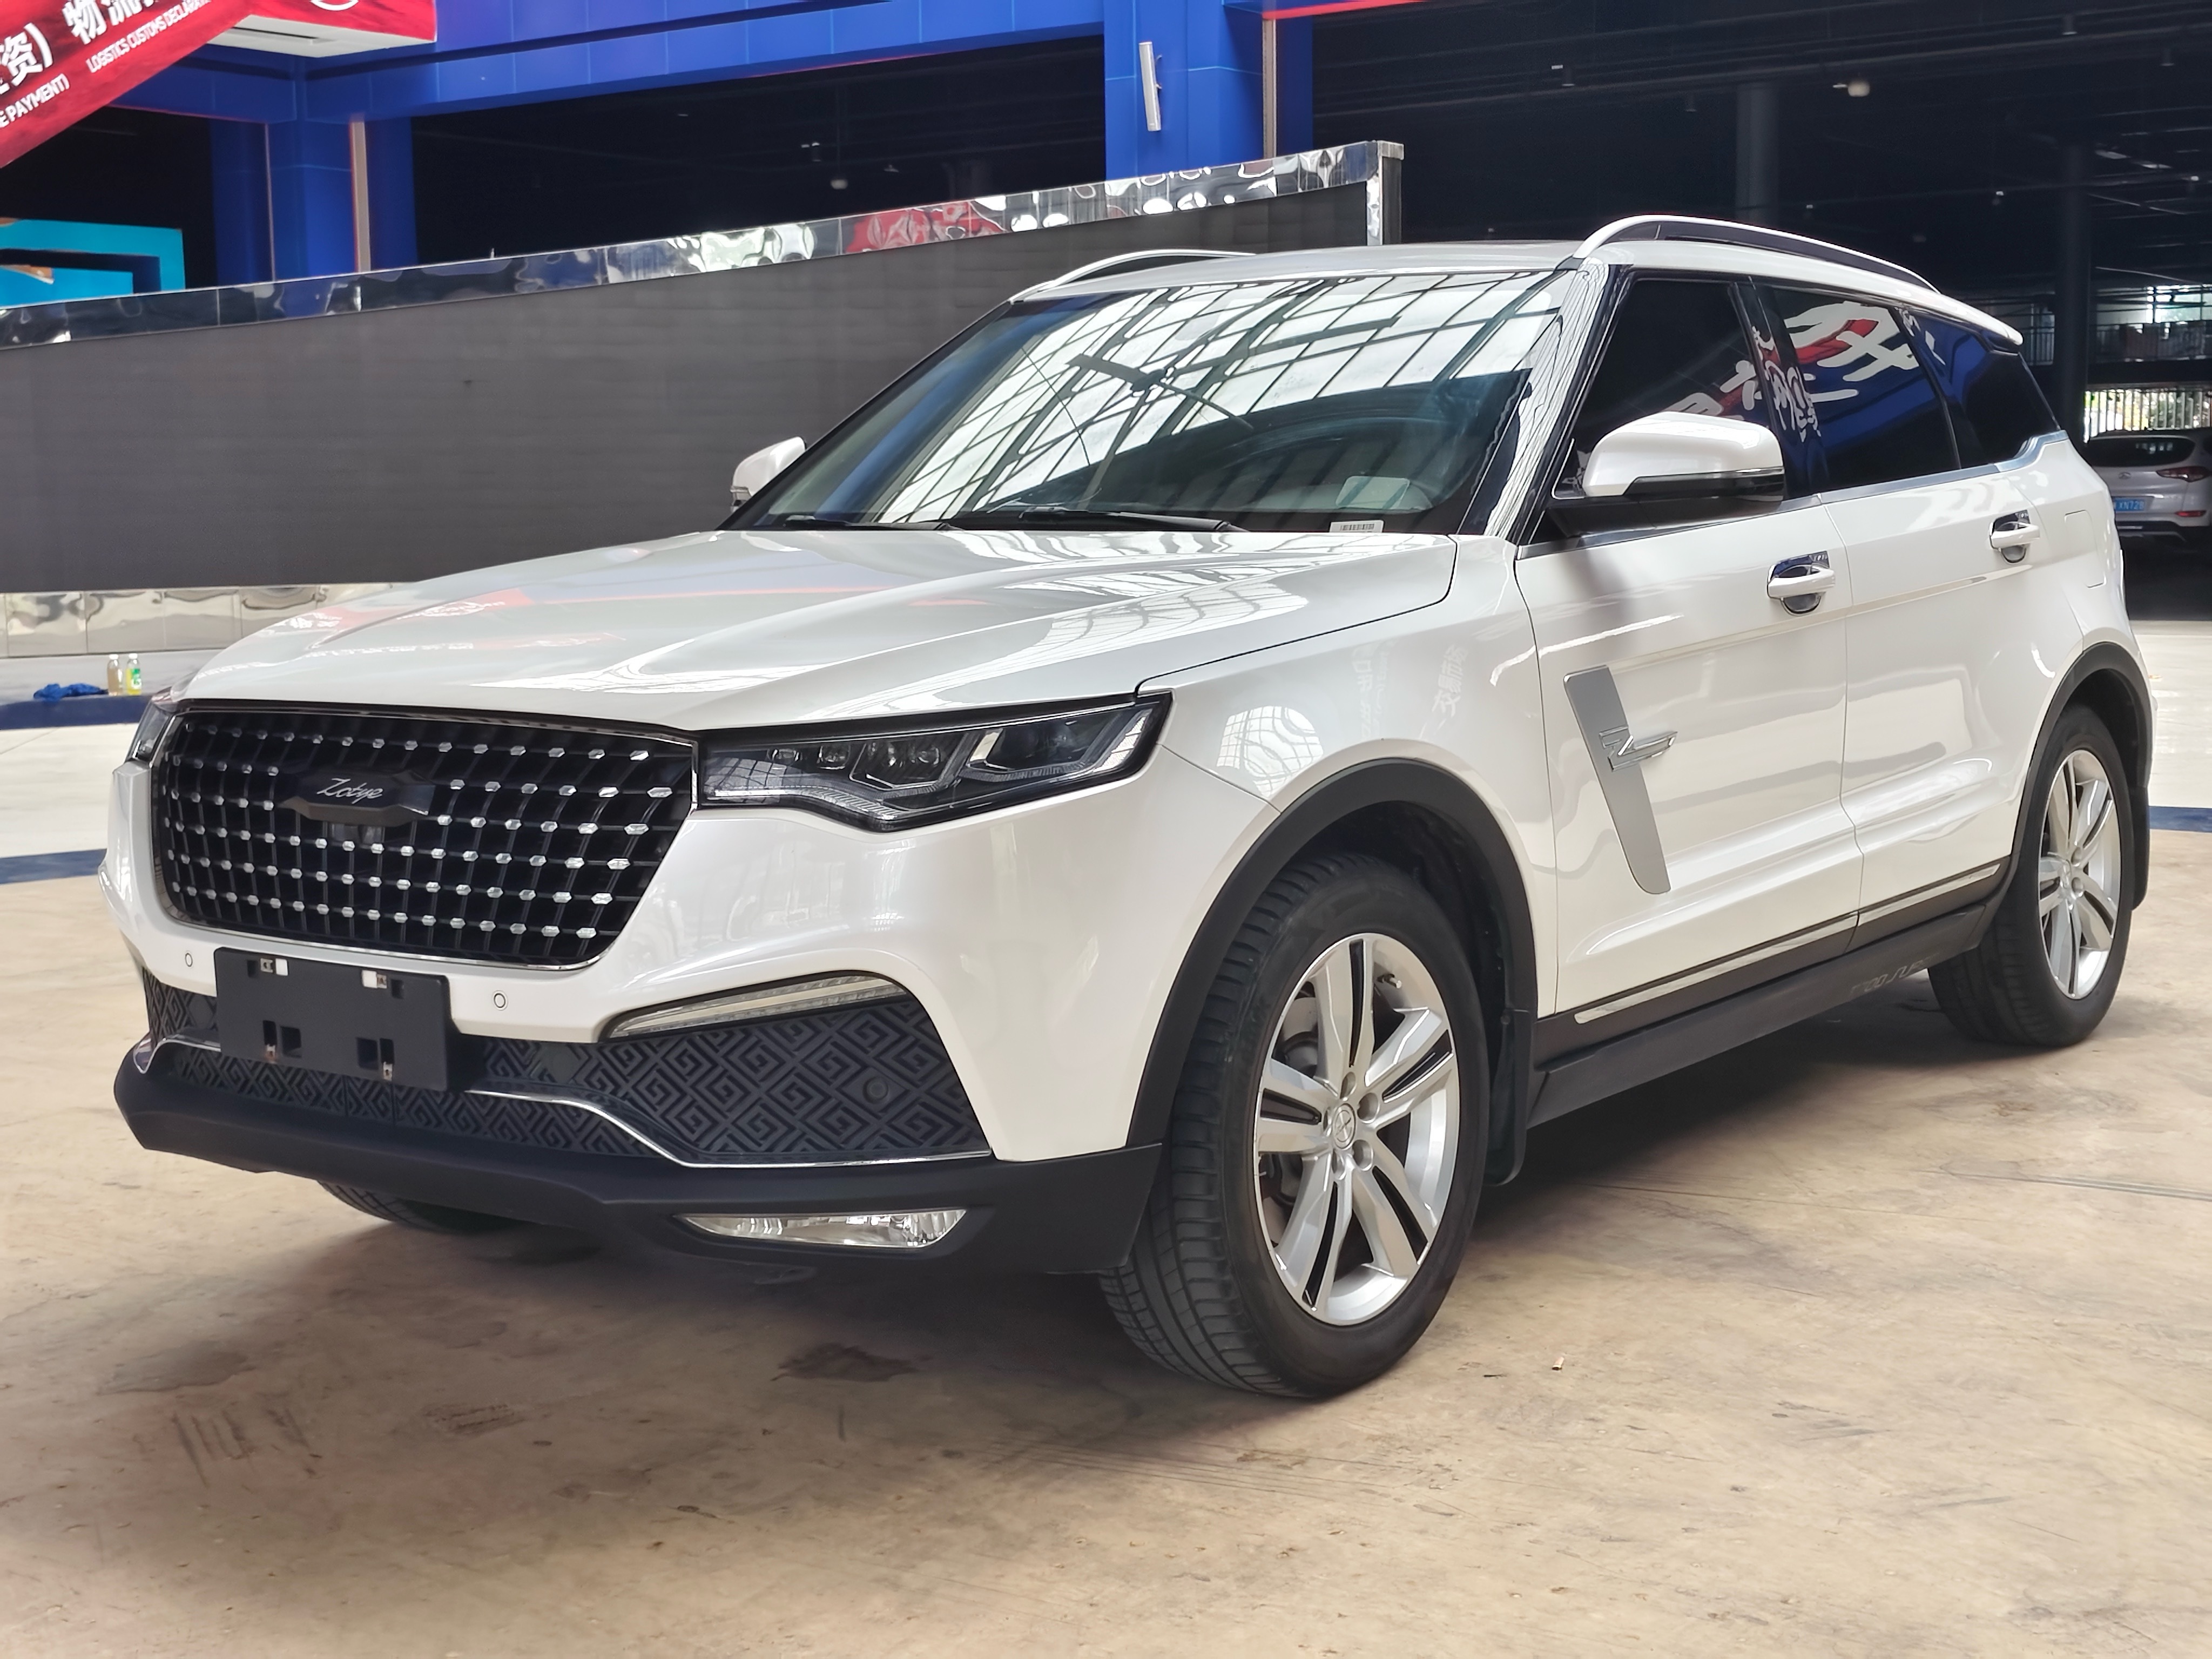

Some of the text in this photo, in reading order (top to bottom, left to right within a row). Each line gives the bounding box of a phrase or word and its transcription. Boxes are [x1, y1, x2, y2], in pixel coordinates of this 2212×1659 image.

[0, 23, 53, 95] 资)
[5, 73, 70, 122] PAYMENT)
[86, 38, 130, 73] LOGISTICS
[126, 16, 166, 48] CUSTOMS
[316, 778, 383, 804] Zotye
